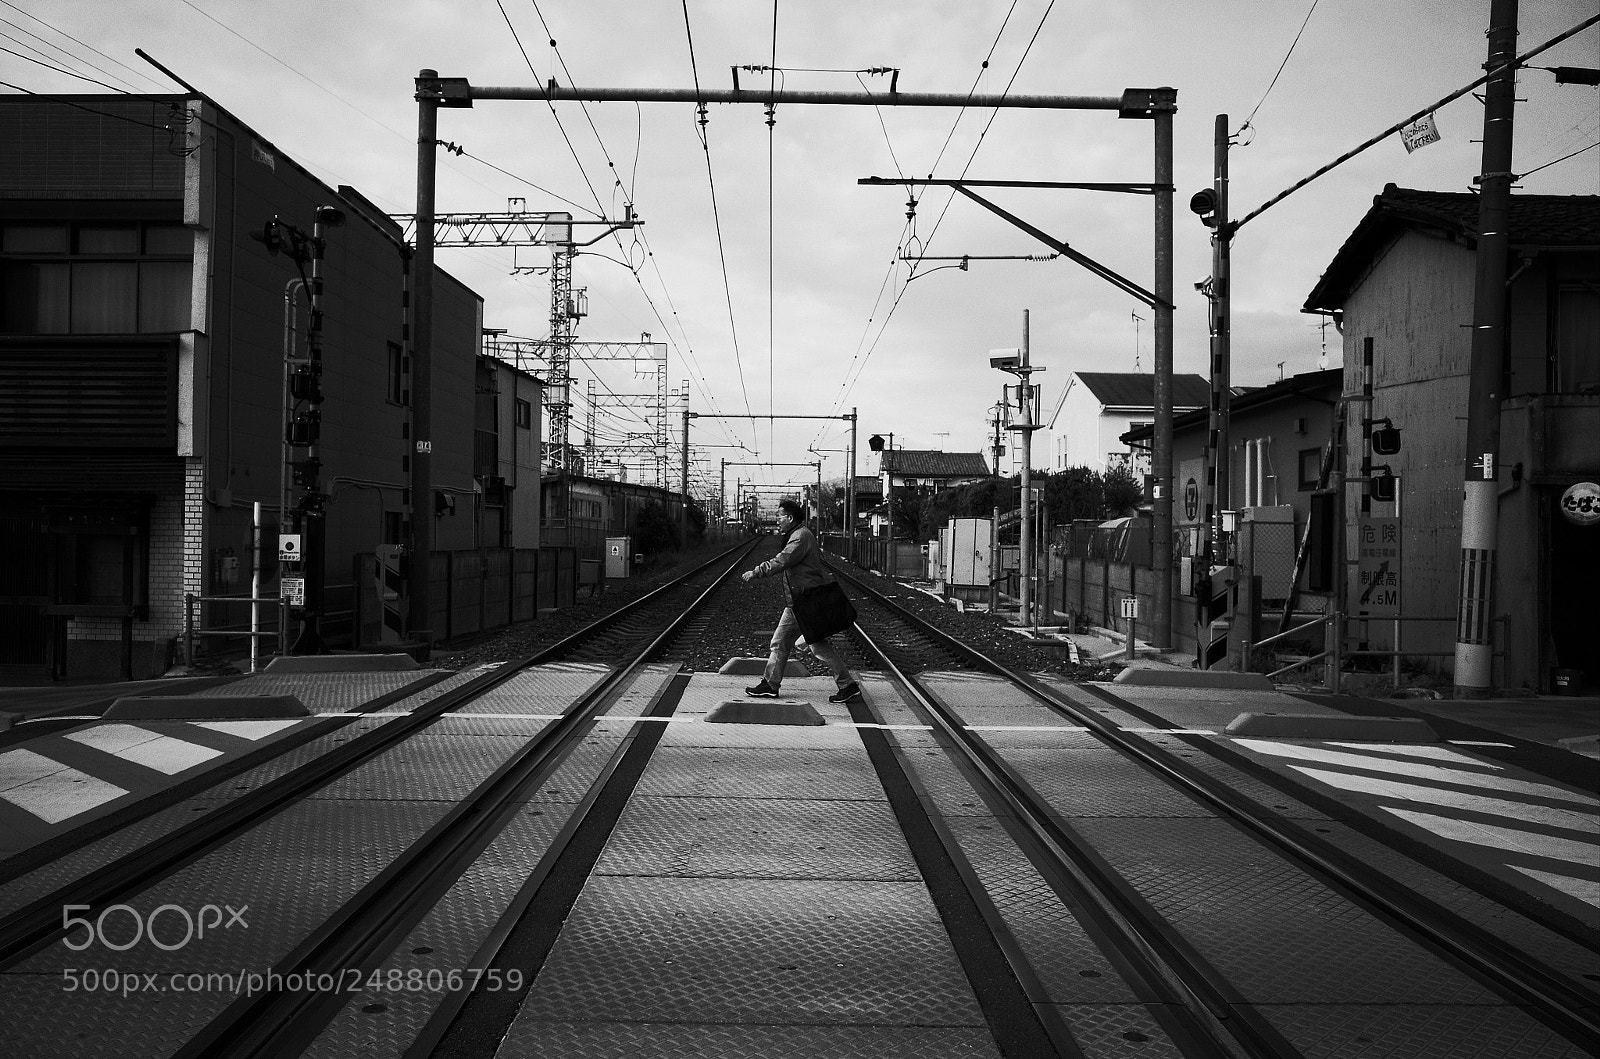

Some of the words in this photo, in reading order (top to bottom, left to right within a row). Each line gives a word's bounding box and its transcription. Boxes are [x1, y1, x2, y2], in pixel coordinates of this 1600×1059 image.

[1361, 524, 1397, 543] 危険
[1361, 571, 1397, 587] 制限高
[1361, 590, 1397, 606] 4.5M
